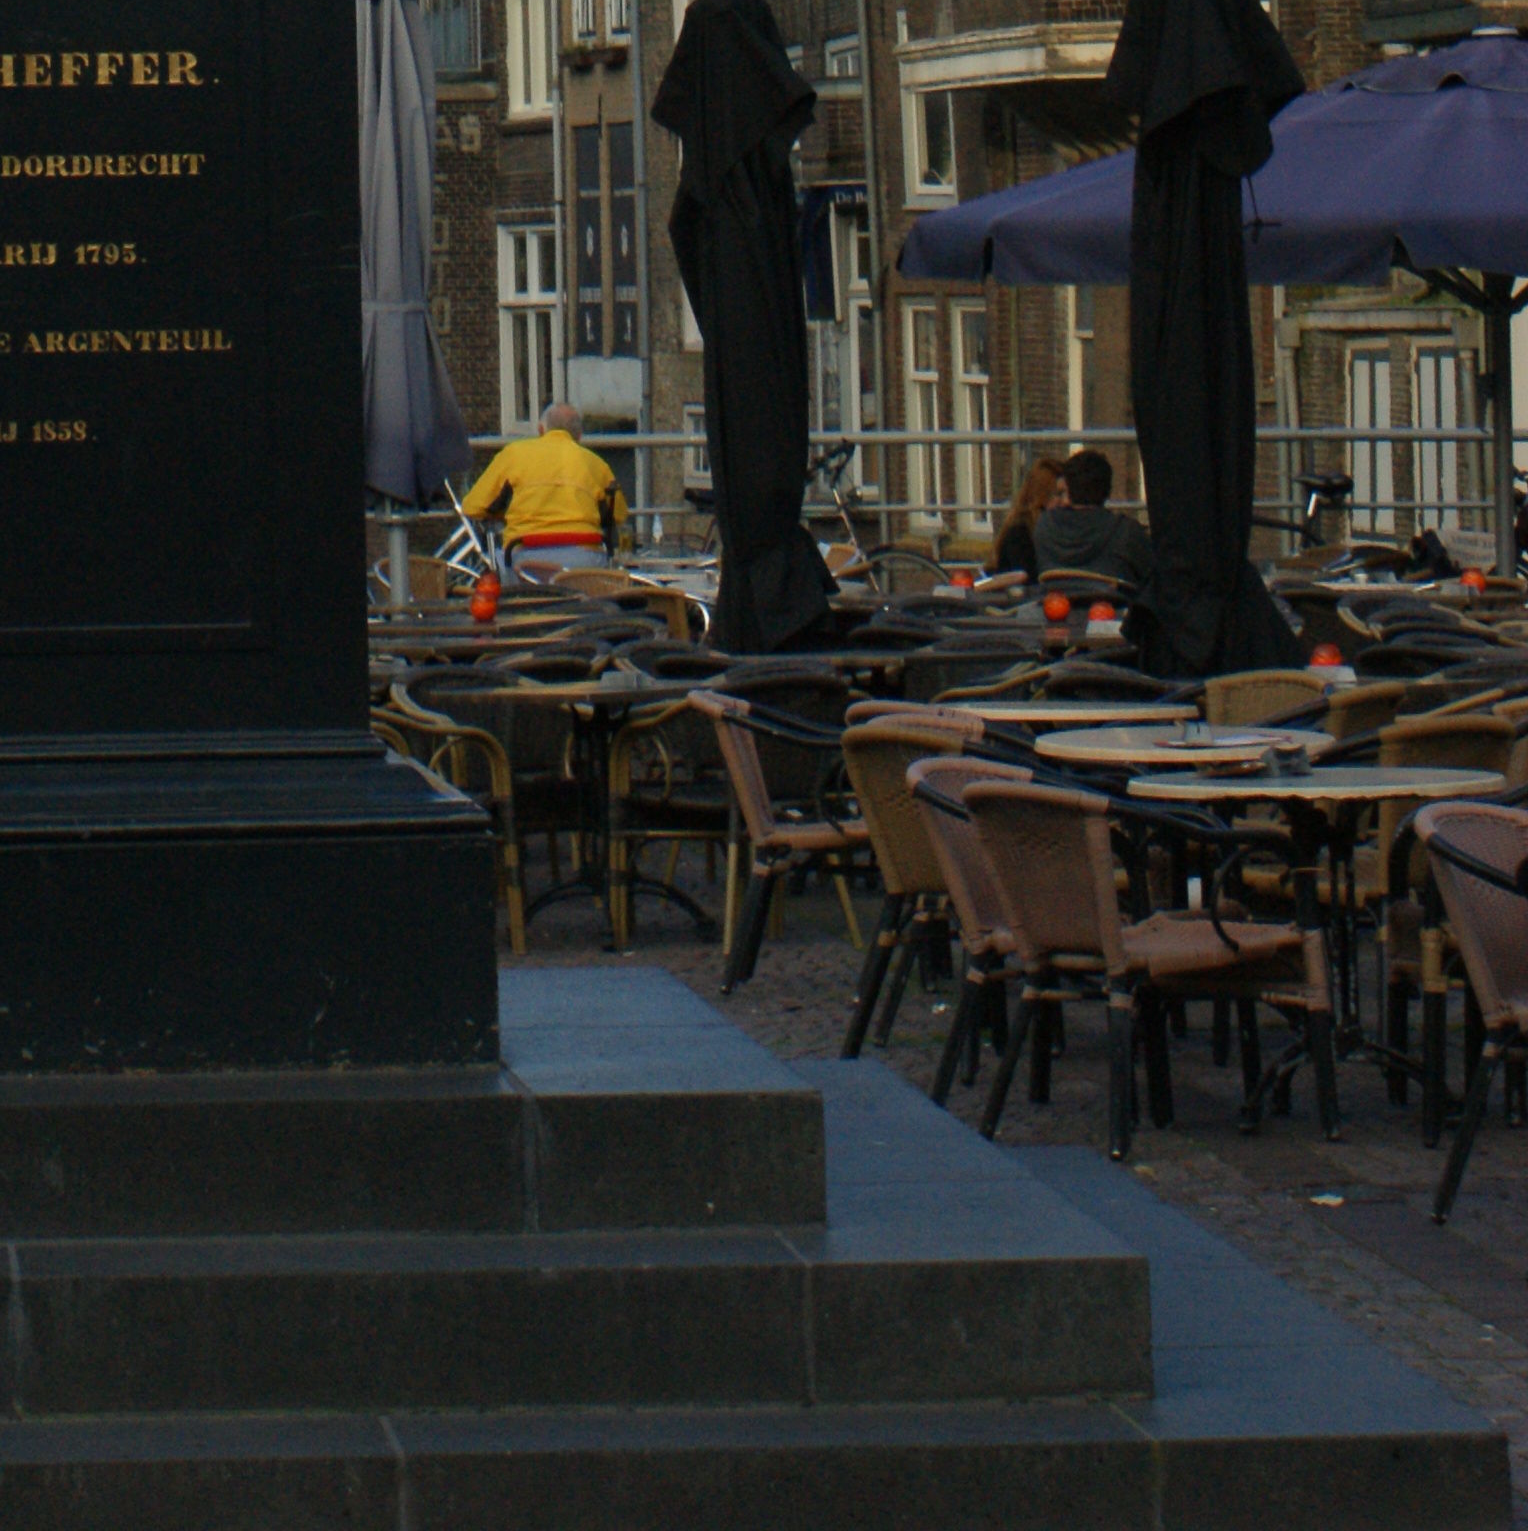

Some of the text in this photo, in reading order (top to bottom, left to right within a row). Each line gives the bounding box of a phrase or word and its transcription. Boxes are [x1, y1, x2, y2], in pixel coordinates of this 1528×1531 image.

[0, 152, 206, 178] DORDRECHT
[74, 242, 147, 265] 1795.
[23, 328, 233, 354] ARGENTEUIL
